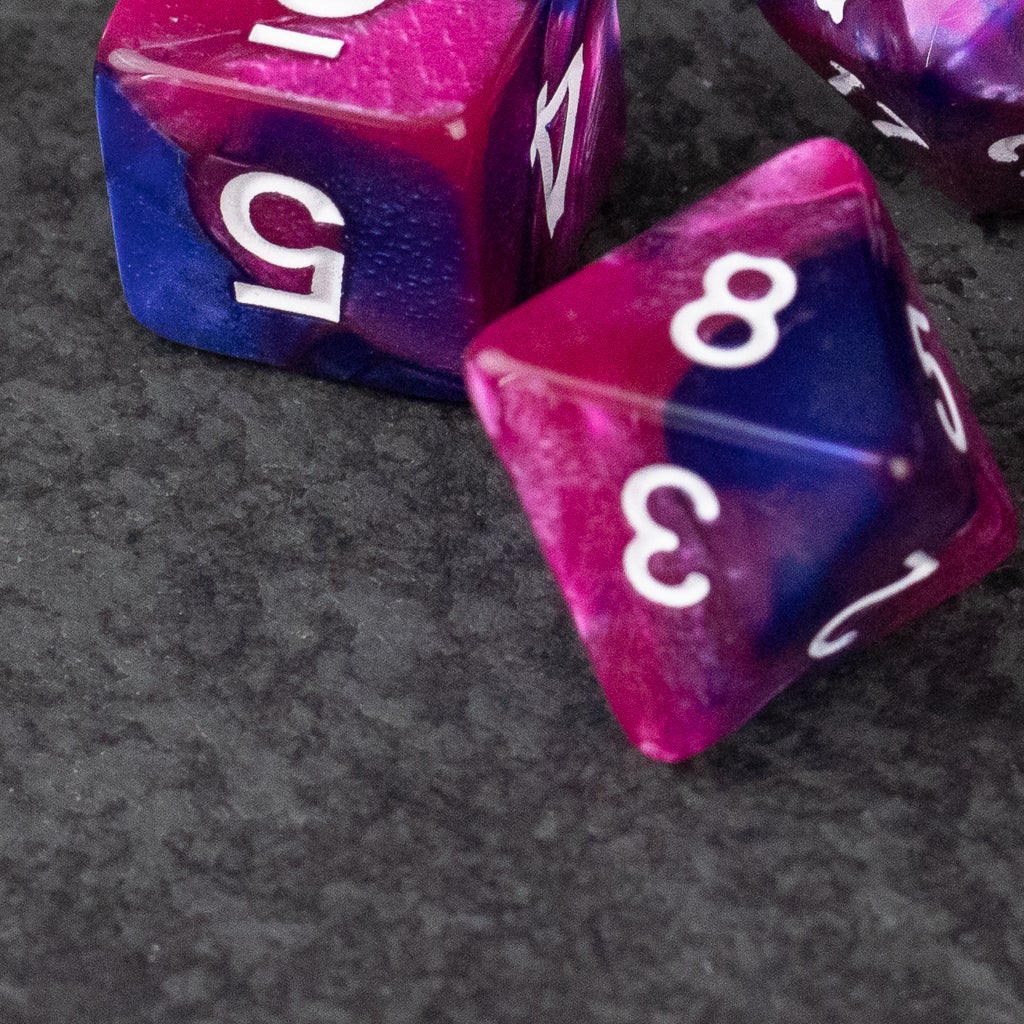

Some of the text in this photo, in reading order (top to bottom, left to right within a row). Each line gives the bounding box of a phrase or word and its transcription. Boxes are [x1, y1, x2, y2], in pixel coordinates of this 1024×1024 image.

[529, 42, 585, 239] 4
[219, 171, 346, 324] 5
[669, 251, 797, 368] 8
[620, 463, 721, 609] 3
